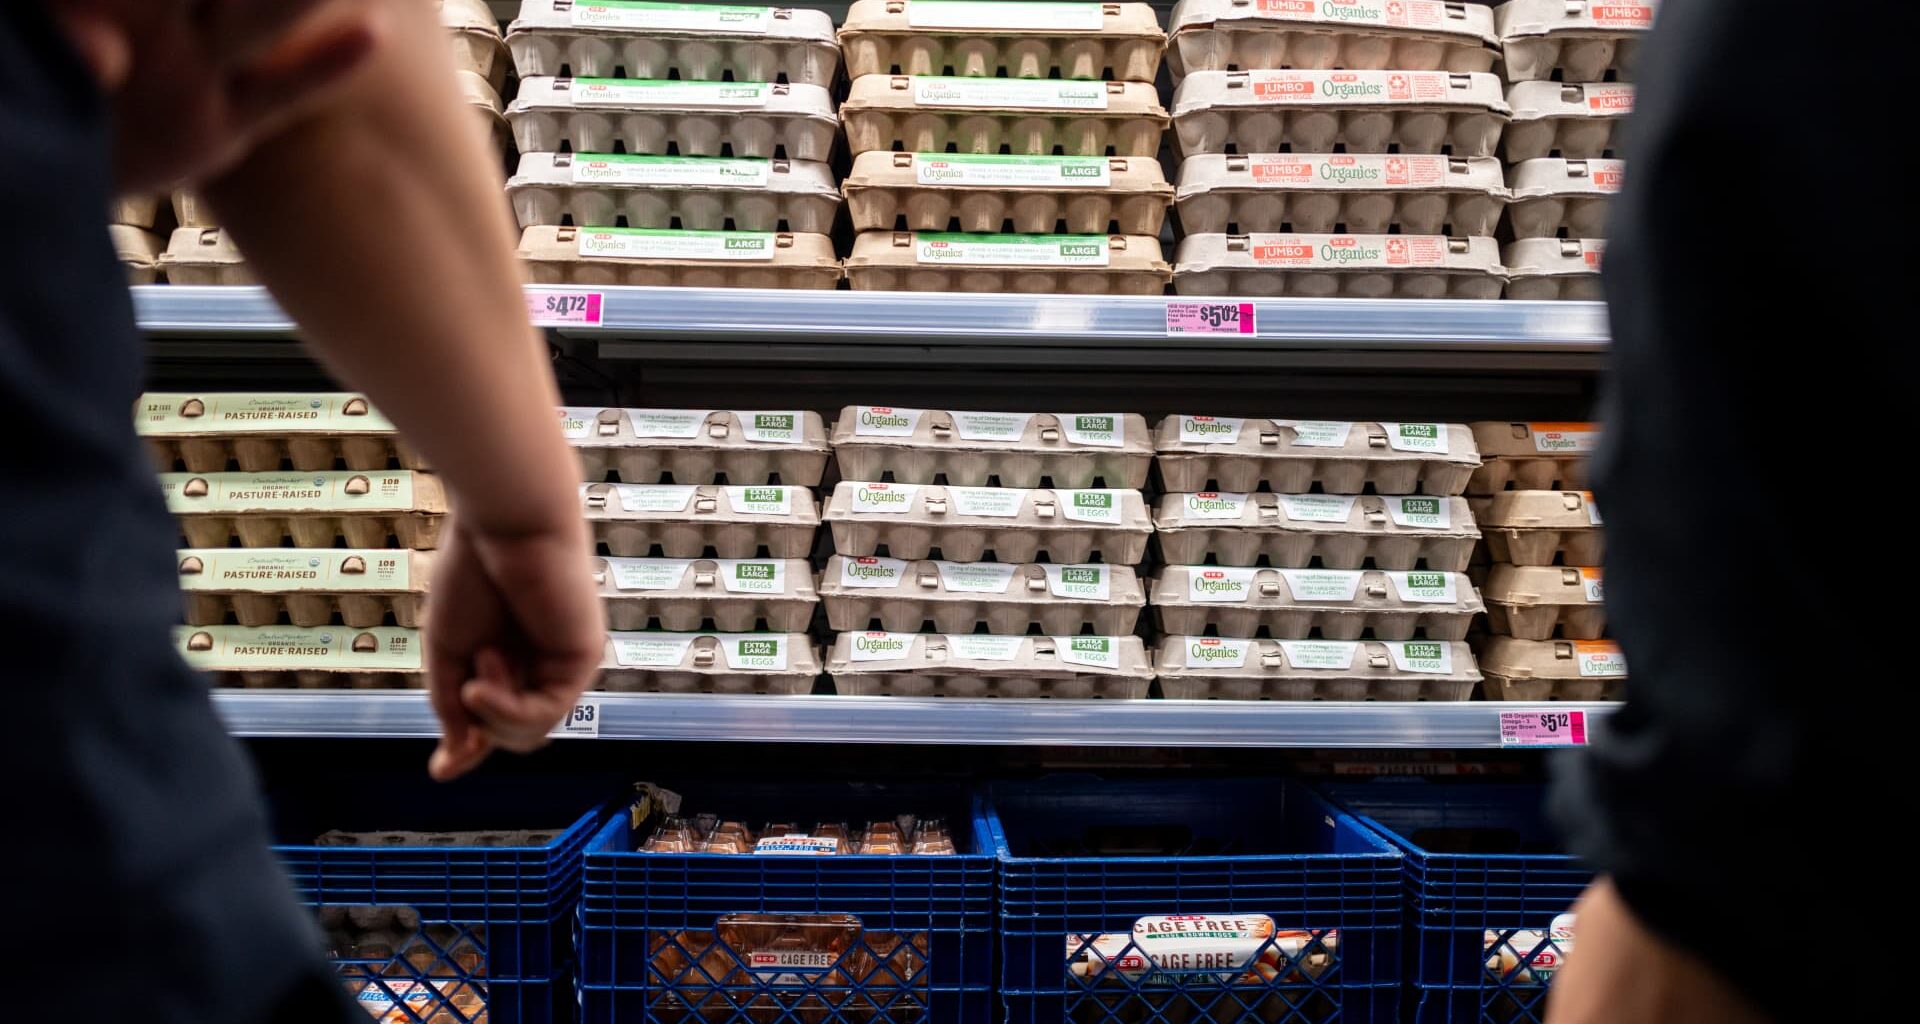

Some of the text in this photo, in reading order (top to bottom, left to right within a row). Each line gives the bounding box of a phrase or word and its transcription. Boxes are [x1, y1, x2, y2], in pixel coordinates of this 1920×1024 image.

[1322, 3, 1379, 20] Organics
[1602, 8, 1641, 18] JUMBO
[1264, 83, 1304, 94] JUMBO
[1322, 80, 1380, 99] Organics
[581, 167, 621, 179] Organics
[924, 167, 963, 180] Organics
[1064, 168, 1098, 176] LARGE
[1262, 165, 1302, 176] JUMBO
[1320, 163, 1378, 184] Organics
[586, 239, 626, 252] Organics
[728, 240, 762, 248] LARGE
[924, 247, 962, 260] Organics
[1264, 246, 1304, 258] JUMBO
[1321, 245, 1378, 264] Organics
[862, 412, 908, 428] Organics
[758, 430, 791, 438] 18 EGGS
[1186, 420, 1232, 436] Organics
[1088, 432, 1112, 440] EGGS
[1413, 438, 1436, 447] EGGS
[1540, 439, 1576, 450] Organics
[858, 488, 905, 505] Organics
[757, 504, 780, 512] EGGS
[1189, 496, 1236, 513] Organics
[1086, 510, 1110, 518] EGGS
[1416, 516, 1438, 524] EGGS
[848, 562, 894, 579] Organics
[739, 580, 772, 589] 18 EGGS
[1195, 577, 1242, 594] Organics
[1422, 589, 1444, 597] EGGS
[856, 636, 903, 653] Organics
[1084, 653, 1107, 661] EGGS
[1192, 644, 1238, 661] Organics
[1418, 660, 1440, 668] EGGS
[1586, 660, 1624, 674] Organics
[1134, 920, 1248, 933] CAGE FREE
[781, 954, 832, 965] CAGE FREE
[1152, 952, 1234, 970] CAGE FREE
